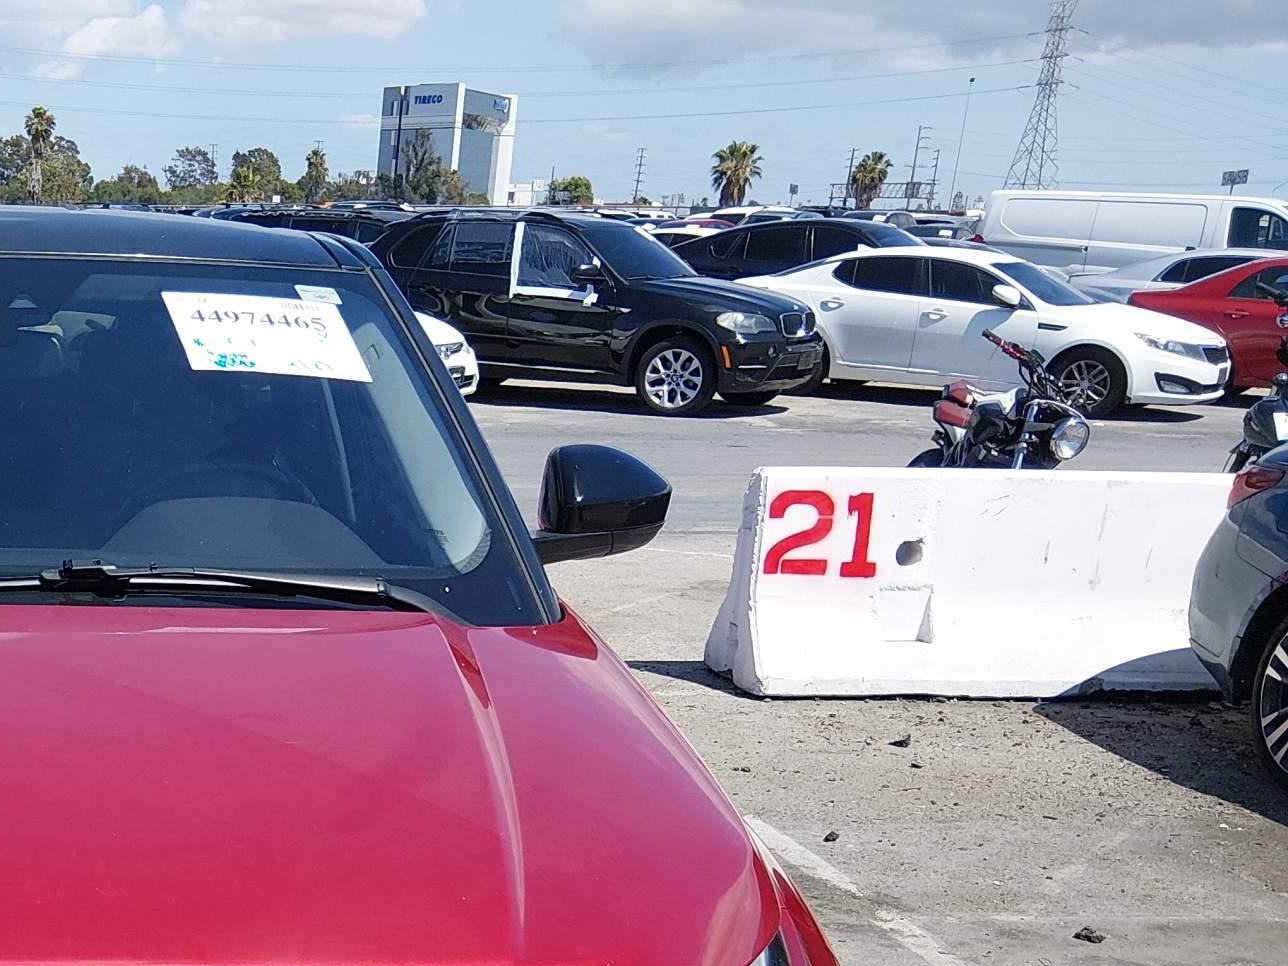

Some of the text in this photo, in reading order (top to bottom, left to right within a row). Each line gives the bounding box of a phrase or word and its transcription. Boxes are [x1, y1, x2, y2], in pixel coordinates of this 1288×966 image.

[414, 94, 443, 105] TIRECO
[190, 308, 327, 332] 44974465
[762, 489, 877, 579] 21
